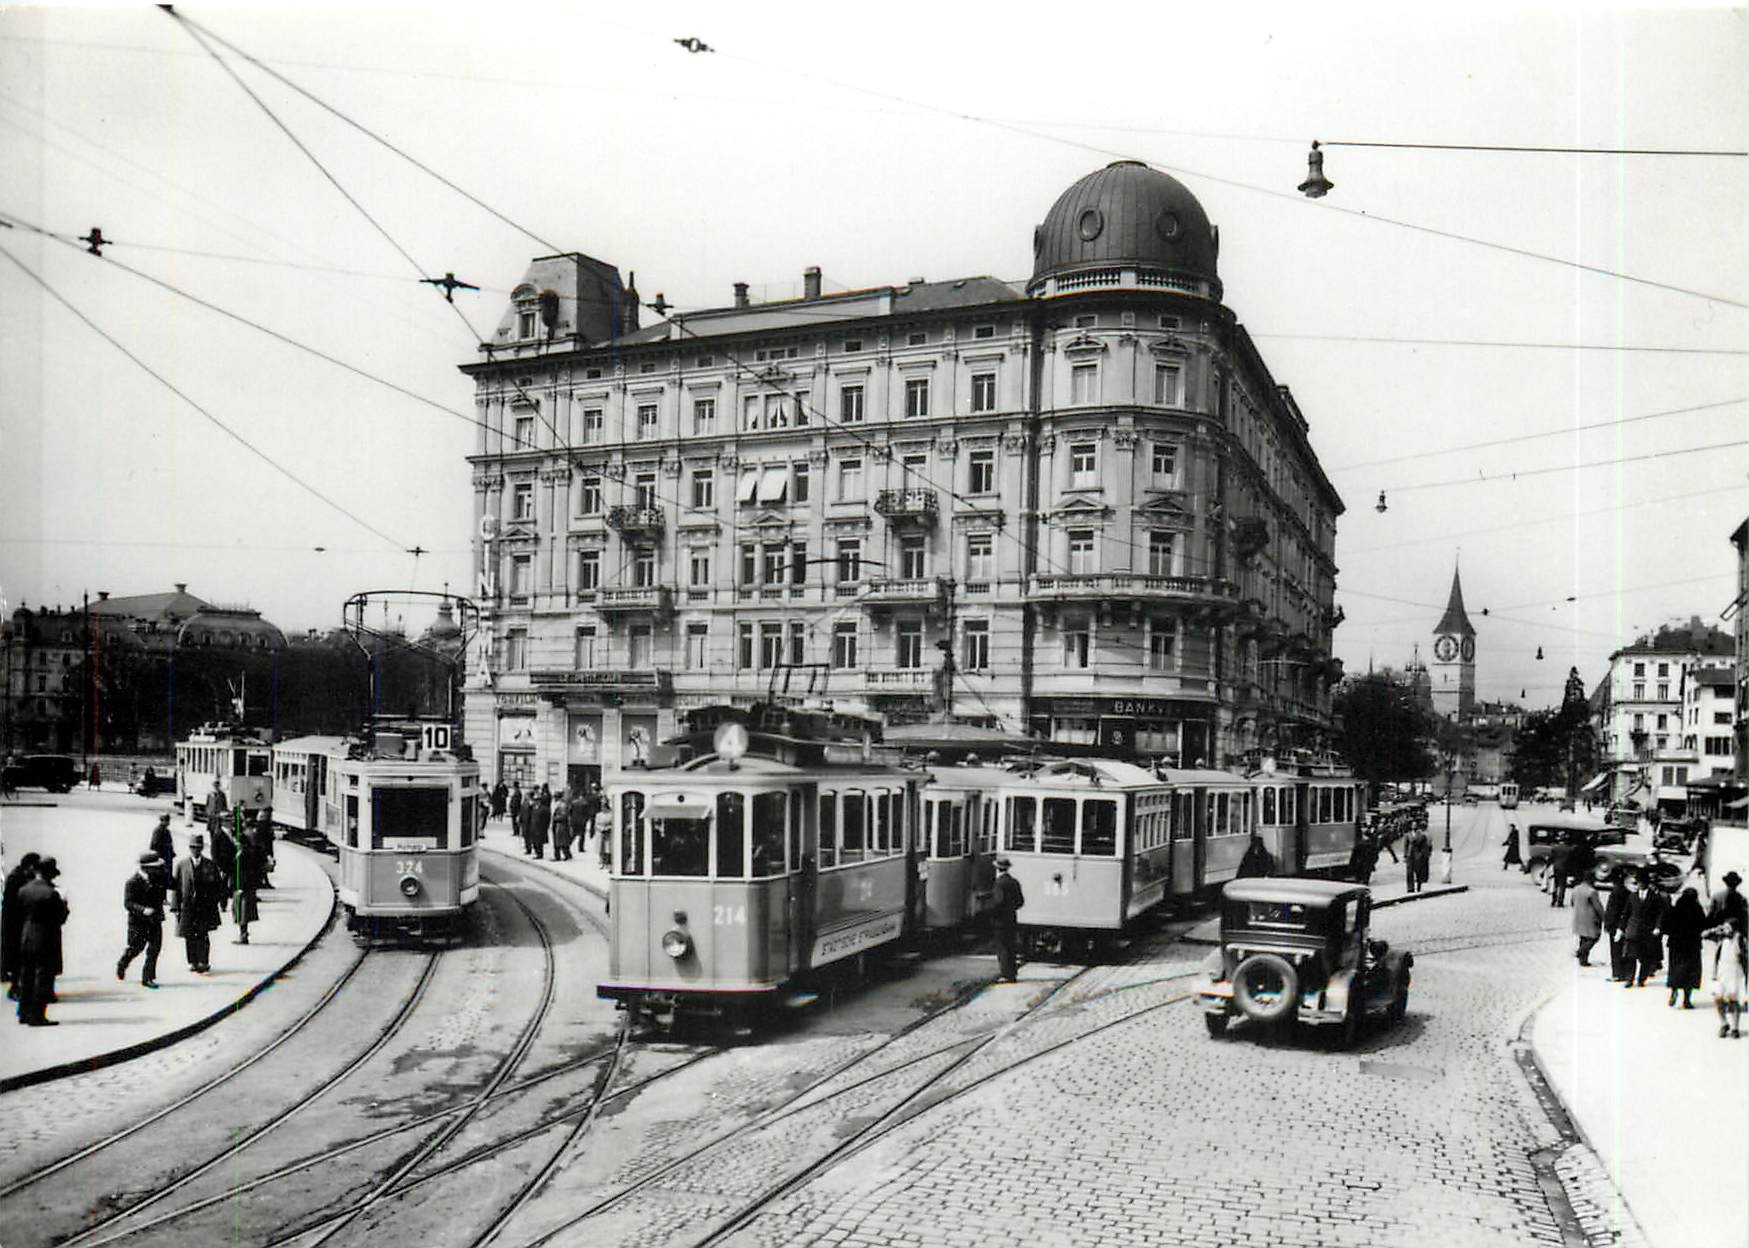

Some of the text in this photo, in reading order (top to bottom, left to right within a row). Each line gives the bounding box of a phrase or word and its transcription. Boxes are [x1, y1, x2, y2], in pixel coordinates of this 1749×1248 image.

[424, 726, 448, 749] 10
[719, 723, 744, 757] 4
[396, 860, 423, 874] 324
[713, 904, 746, 925] 214
